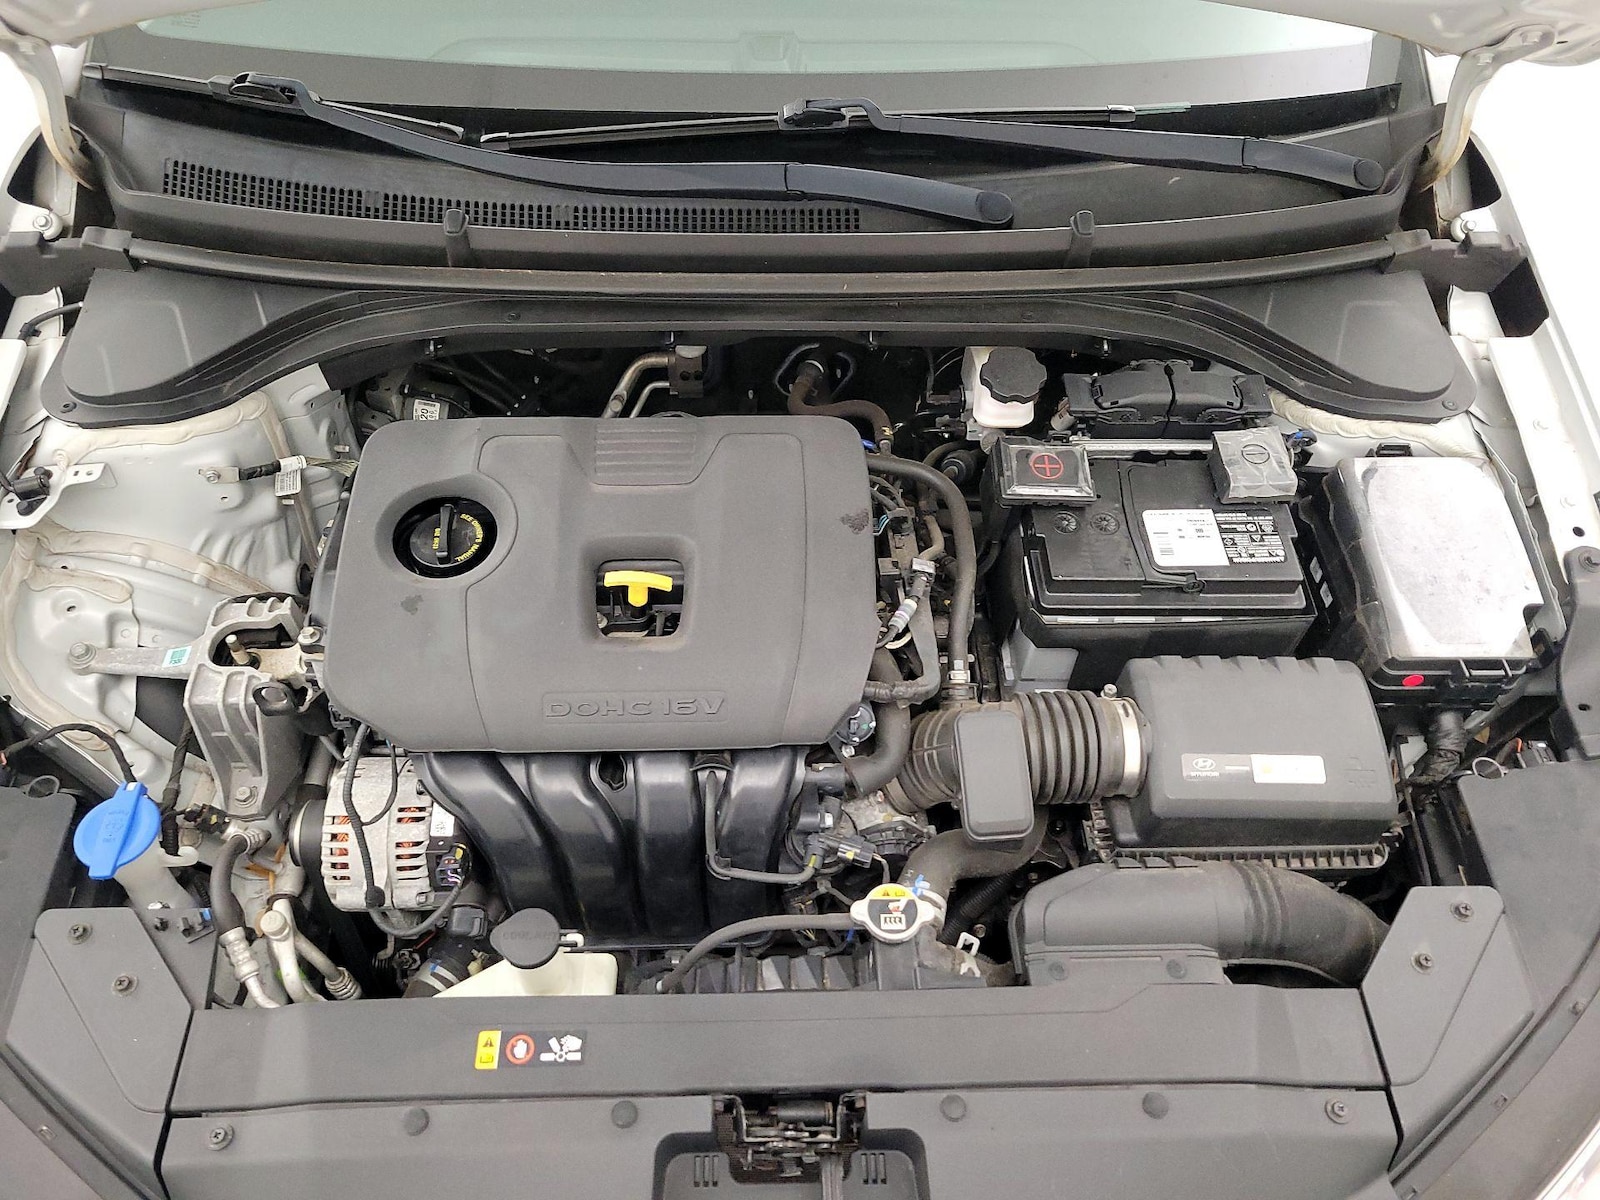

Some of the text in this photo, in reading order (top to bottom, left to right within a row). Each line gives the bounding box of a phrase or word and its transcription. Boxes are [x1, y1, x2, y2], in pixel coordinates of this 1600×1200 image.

[454, 513, 484, 562] SEE OWNER'S MANUAL
[545, 697, 726, 718] DOHC 16V
